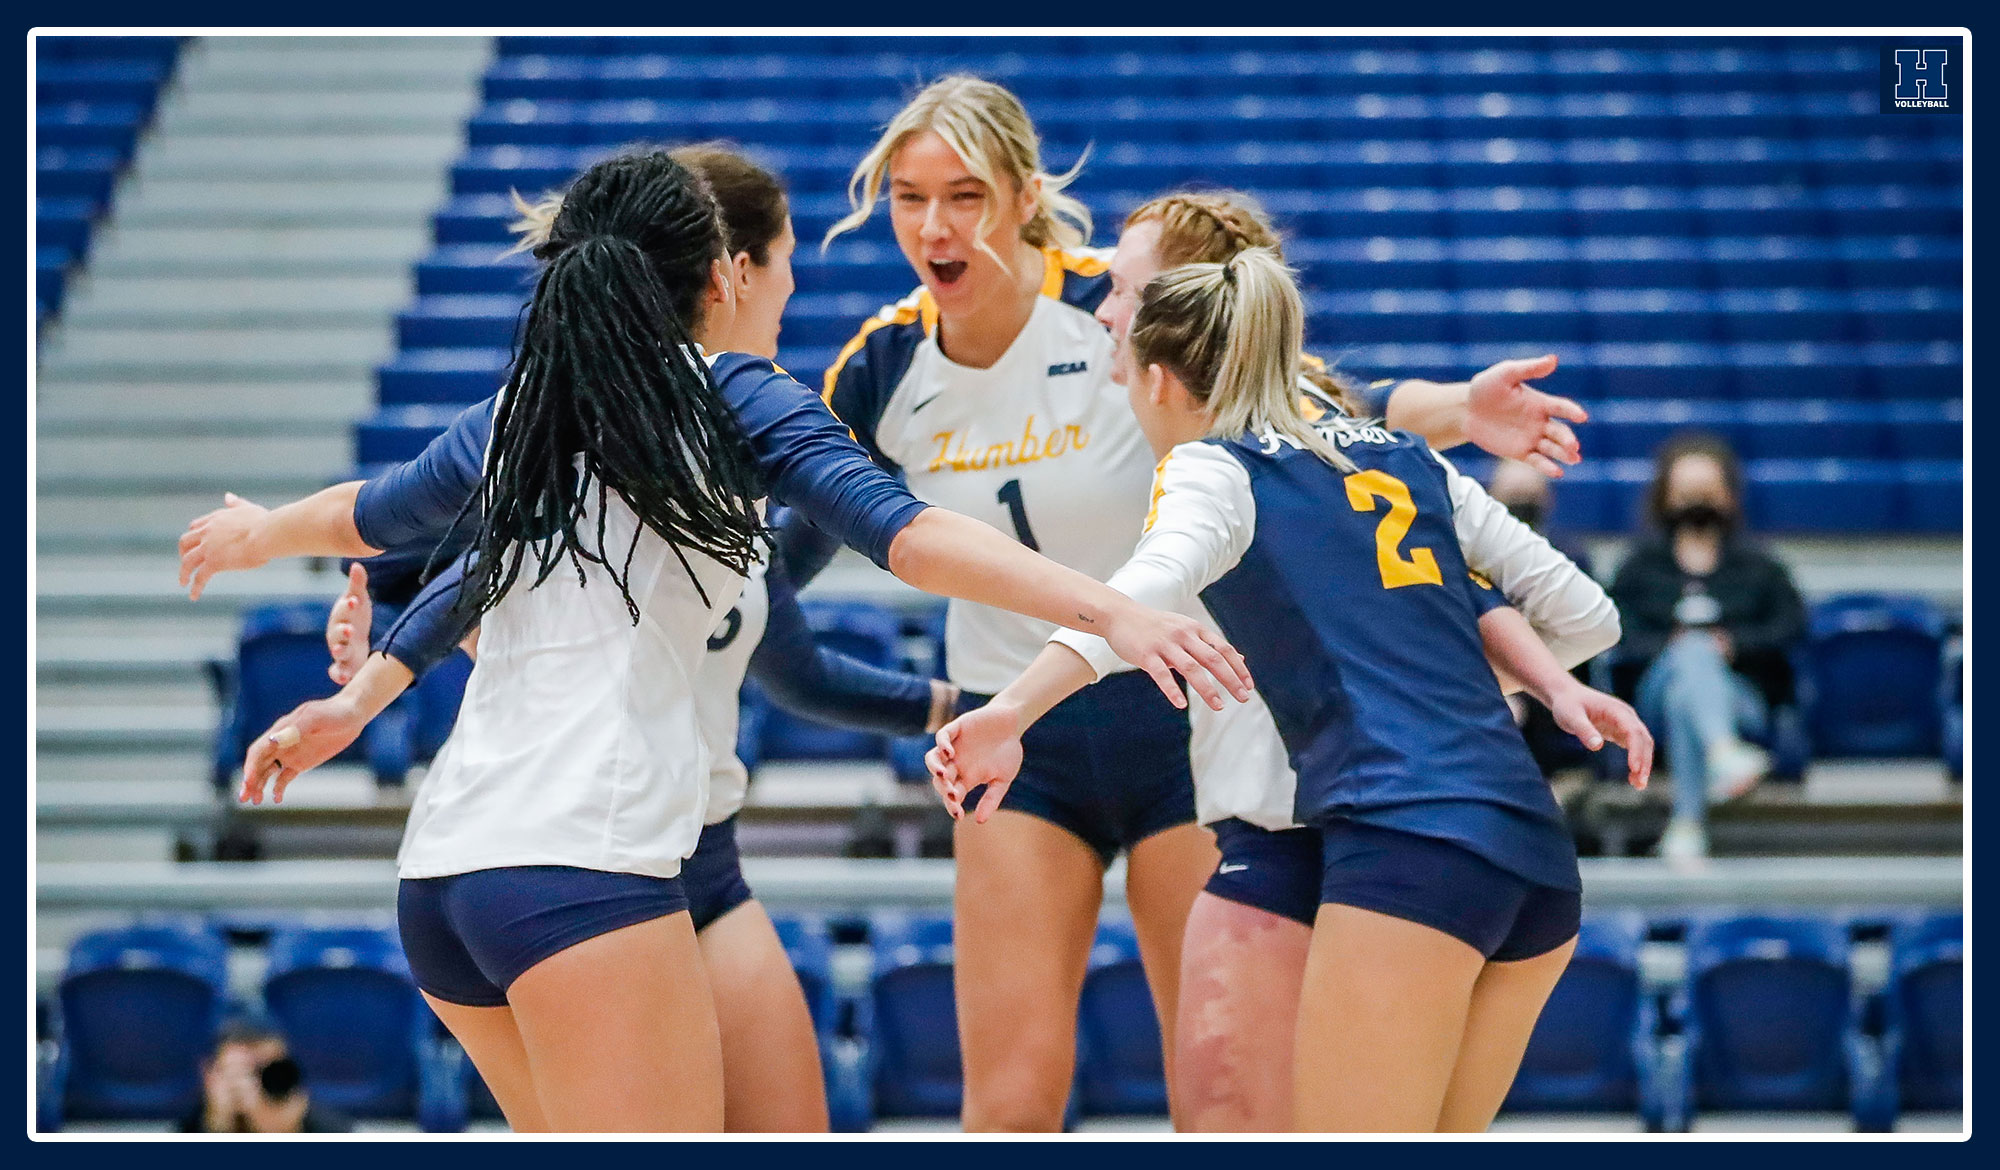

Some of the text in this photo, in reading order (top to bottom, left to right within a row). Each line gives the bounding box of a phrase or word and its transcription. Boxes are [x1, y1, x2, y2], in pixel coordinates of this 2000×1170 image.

[928, 413, 1090, 473] Humber
[997, 479, 1041, 552] 1
[1344, 469, 1443, 589] 2
